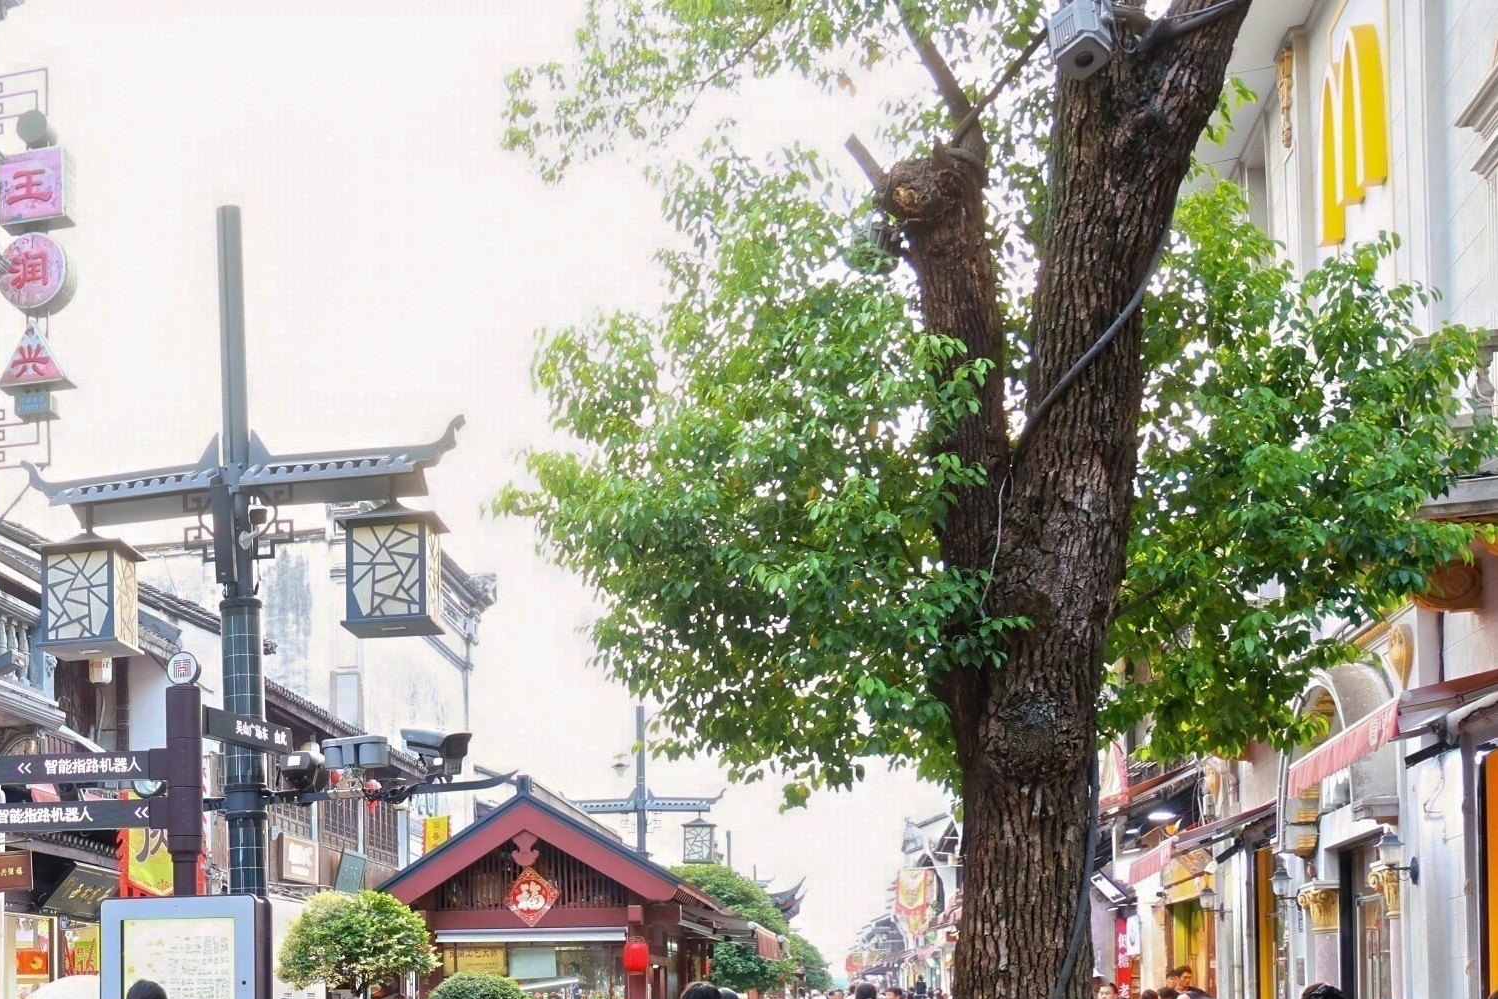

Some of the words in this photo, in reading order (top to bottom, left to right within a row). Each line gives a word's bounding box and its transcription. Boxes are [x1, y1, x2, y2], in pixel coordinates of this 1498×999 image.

[6, 168, 53, 378] 王润兴
[235, 719, 269, 741] 吴山广场东
[44, 756, 142, 775] 智能指路机器人
[515, 881, 545, 911] 福
